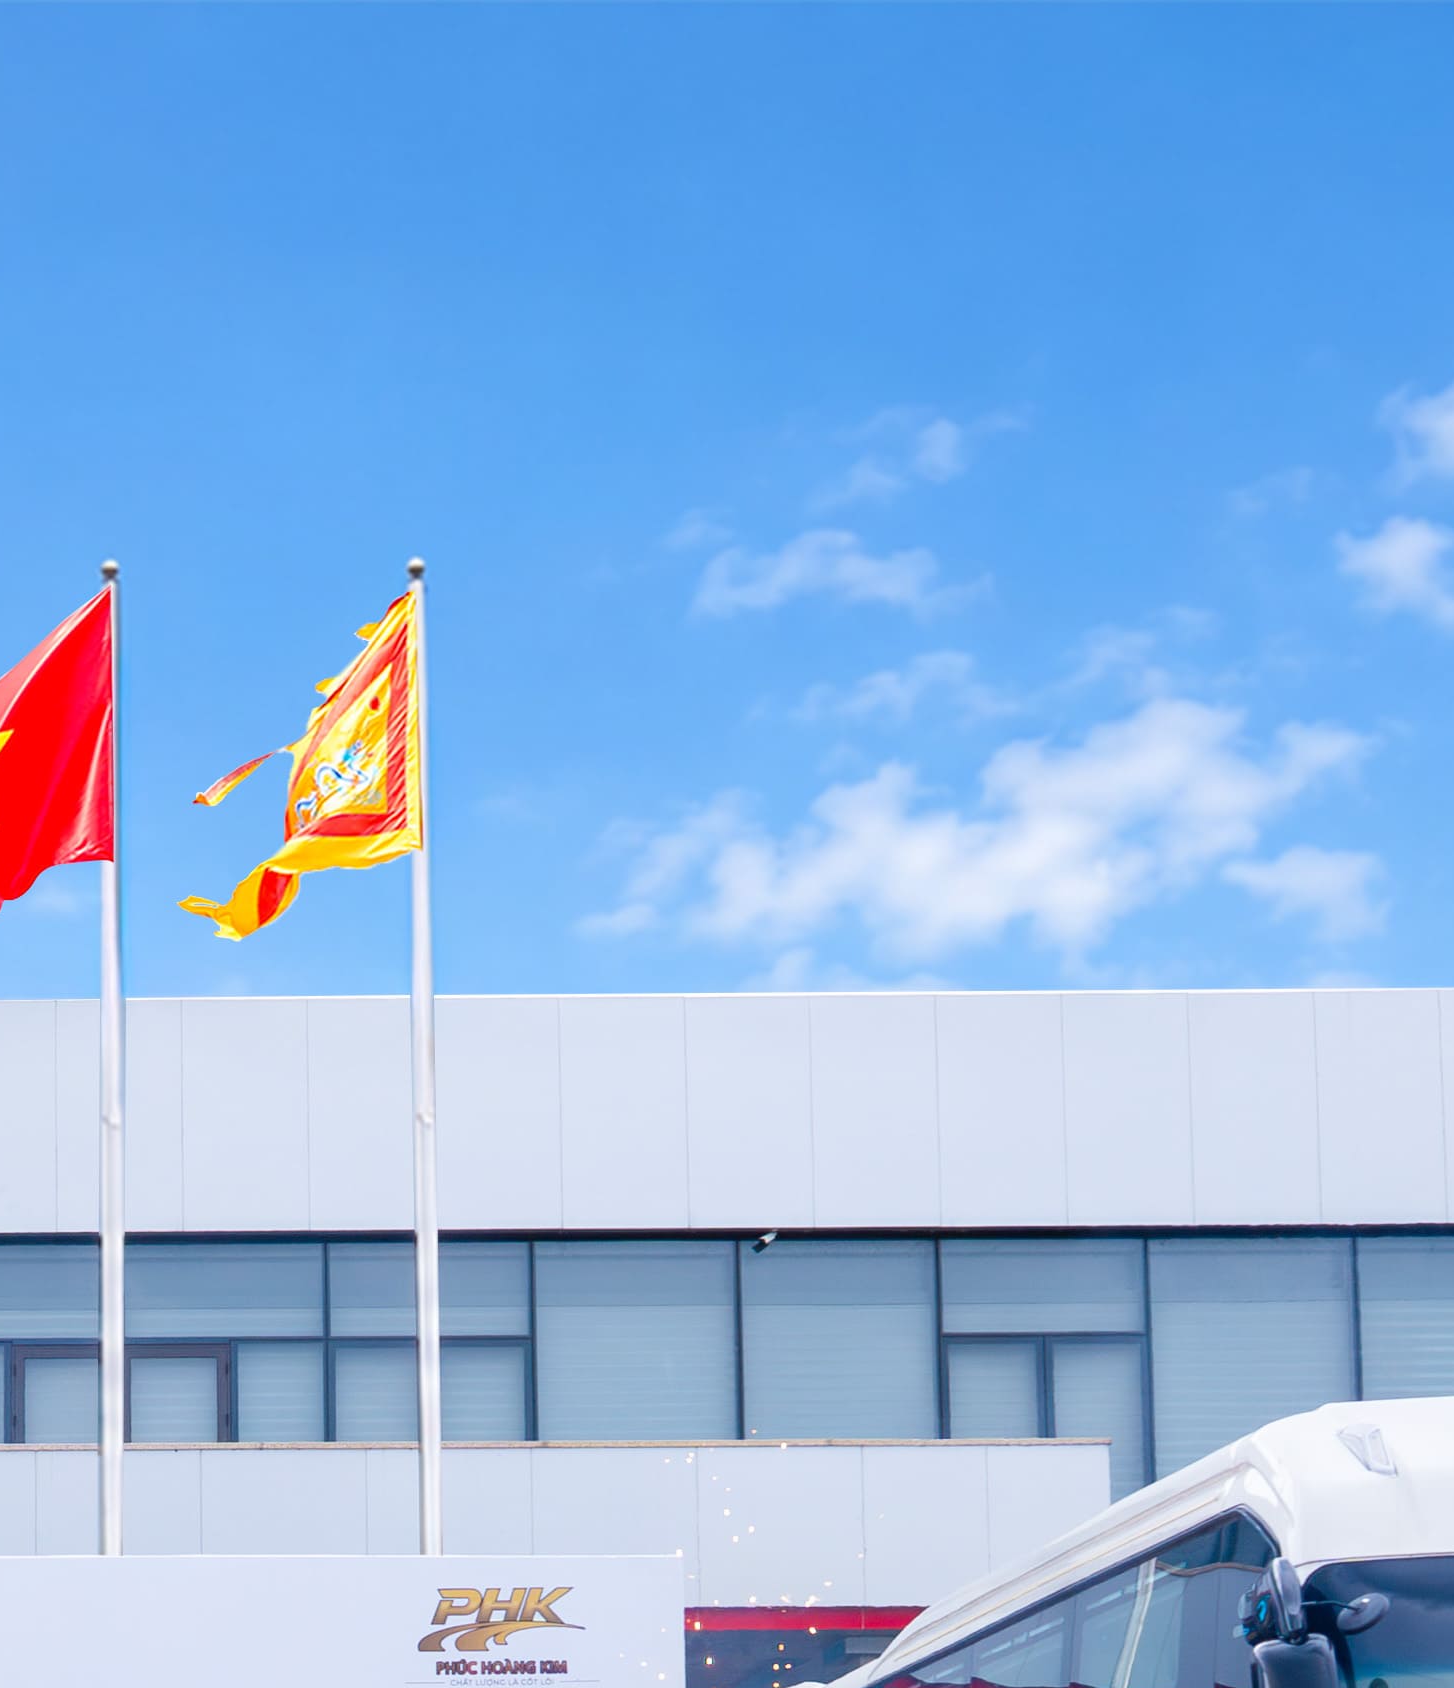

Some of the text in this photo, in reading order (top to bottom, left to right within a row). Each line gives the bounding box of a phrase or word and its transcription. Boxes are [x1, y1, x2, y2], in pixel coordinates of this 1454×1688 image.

[430, 1586, 575, 1626] PHK
[435, 1658, 569, 1676] PHÚC HOÀNG KIM
